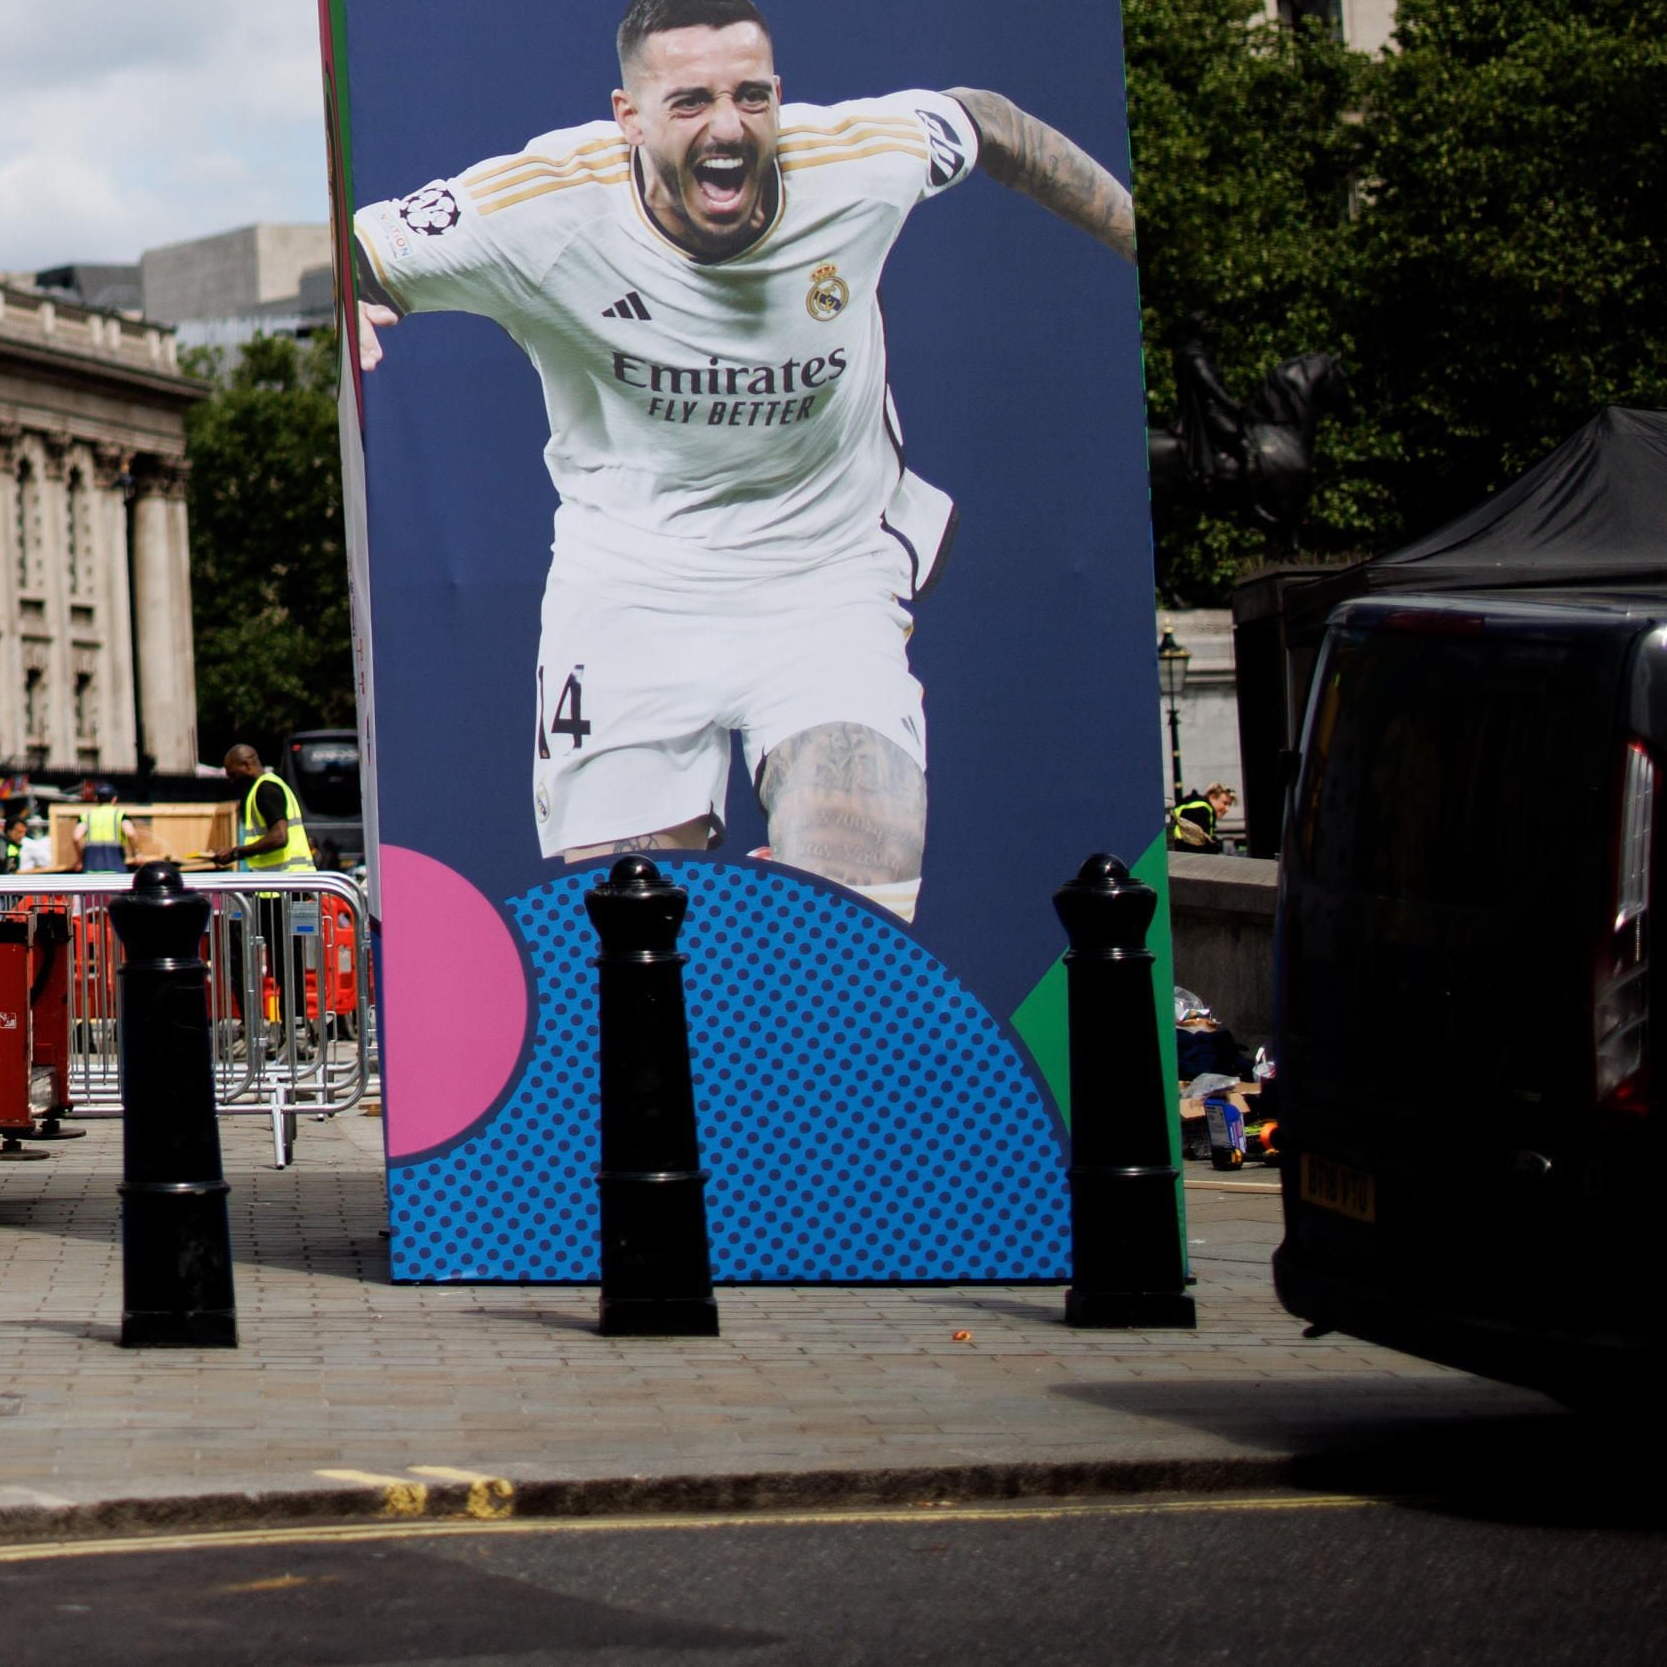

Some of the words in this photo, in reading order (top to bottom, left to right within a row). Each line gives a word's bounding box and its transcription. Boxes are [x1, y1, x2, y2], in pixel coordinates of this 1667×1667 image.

[611, 347, 848, 396] Emirates
[647, 397, 698, 424] FLY
[706, 395, 816, 427] BETTER
